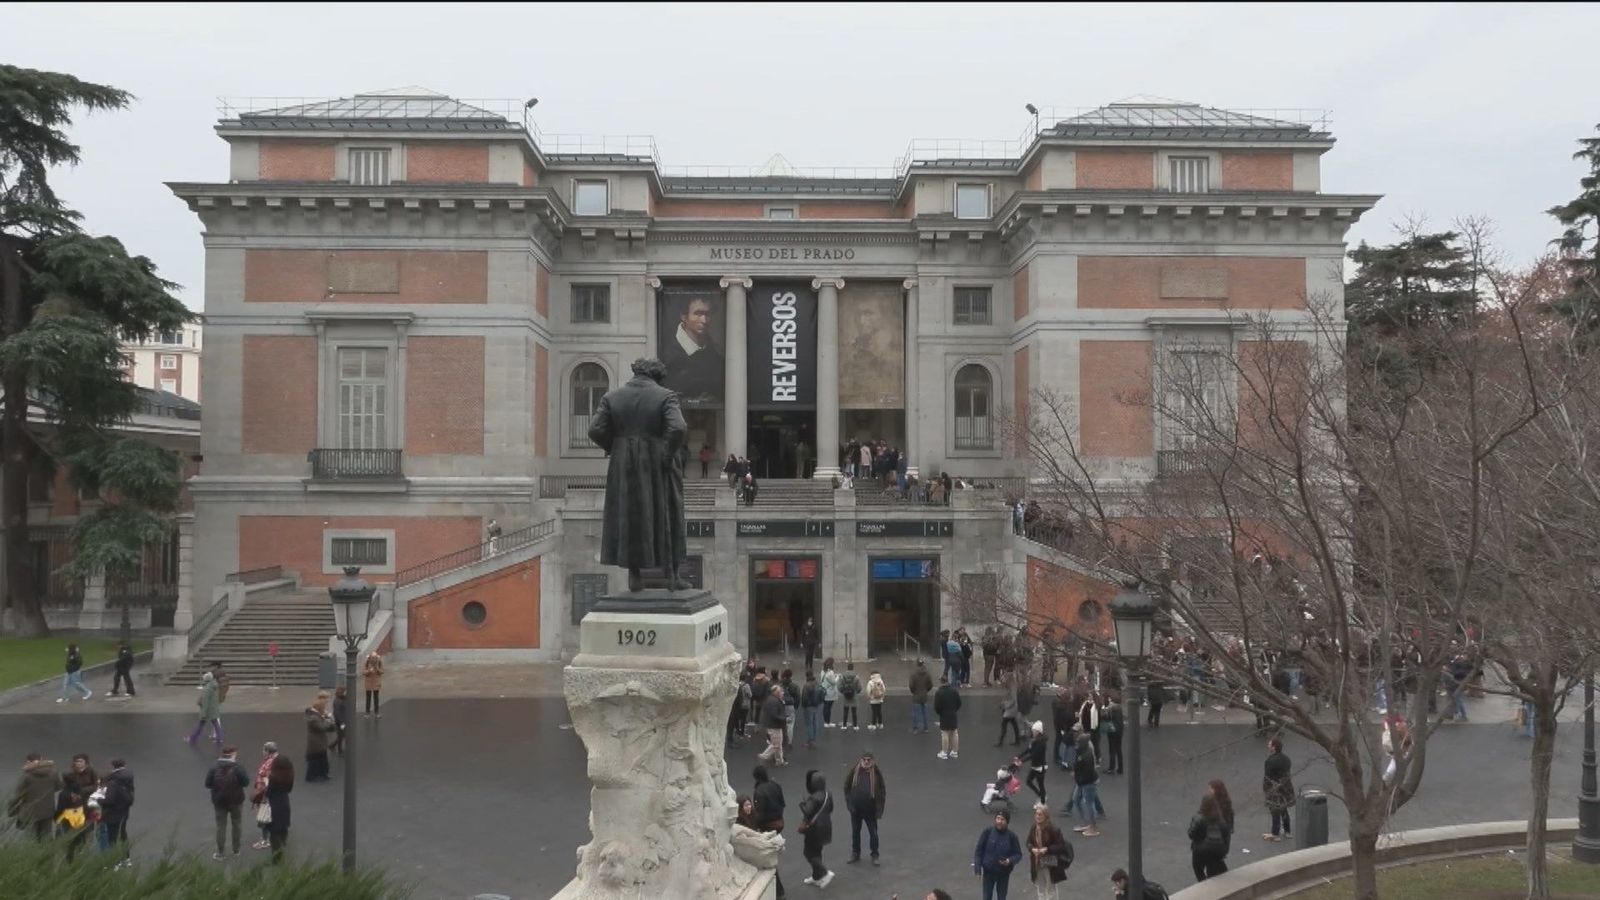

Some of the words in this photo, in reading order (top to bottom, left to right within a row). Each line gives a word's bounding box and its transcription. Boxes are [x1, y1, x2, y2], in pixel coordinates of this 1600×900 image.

[710, 248, 764, 260] MUSEO
[769, 248, 798, 260] DEL
[804, 248, 855, 260] PRADO
[772, 292, 797, 401] REVERSOS
[617, 630, 657, 646] 1902
